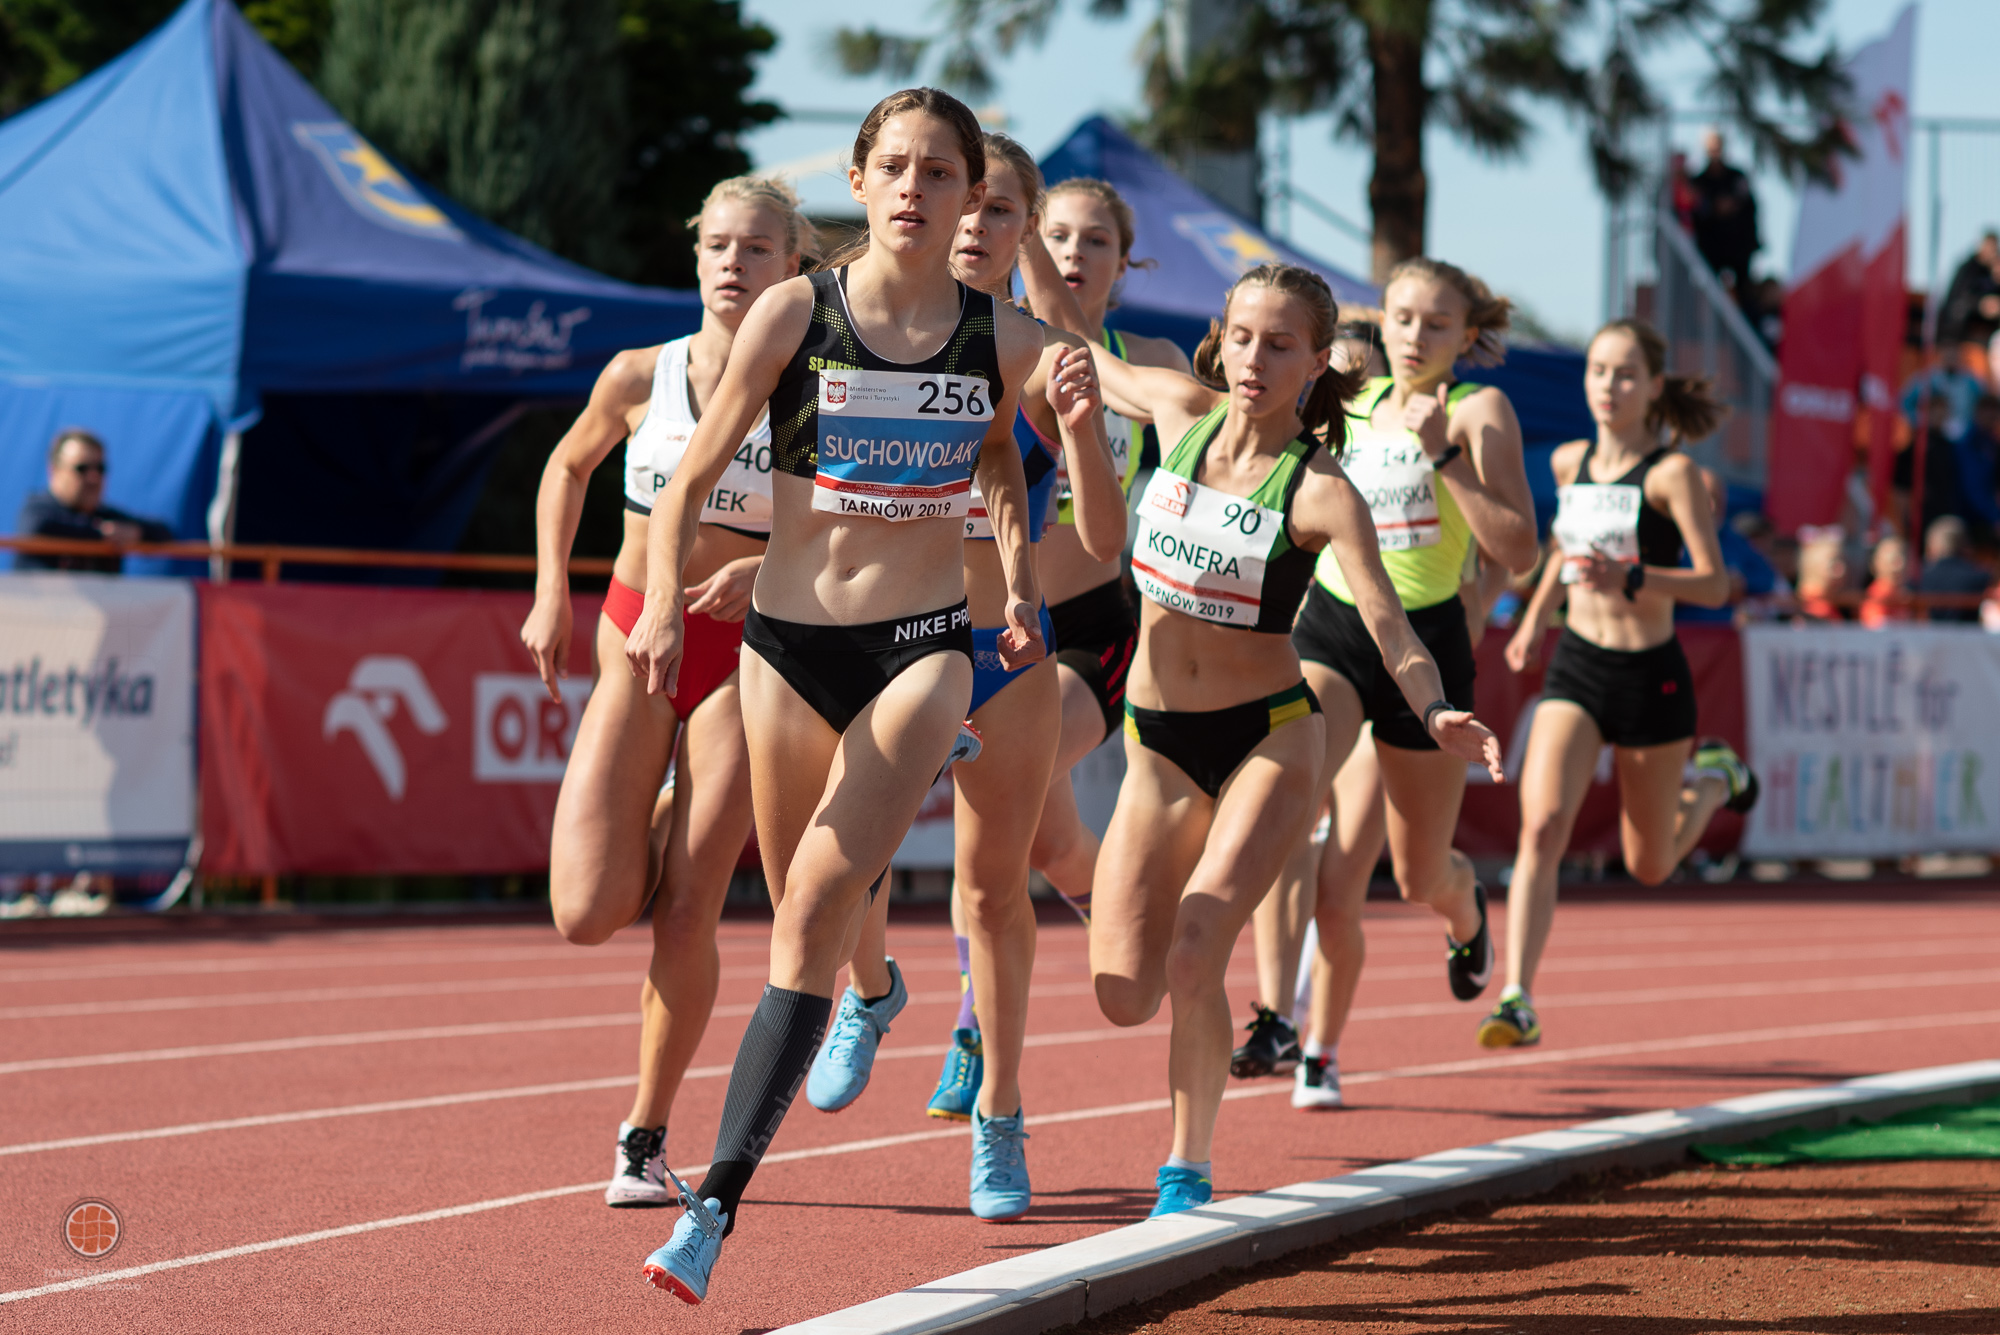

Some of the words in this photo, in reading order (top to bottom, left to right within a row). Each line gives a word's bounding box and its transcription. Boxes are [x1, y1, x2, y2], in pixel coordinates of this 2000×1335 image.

[808, 356, 825, 372] SP
[917, 381, 985, 416] 256
[824, 434, 979, 468] SUCHOWOLAK
[839, 498, 914, 518] TARNÓW
[917, 502, 951, 517] 2019
[1221, 503, 1261, 535] 90
[1148, 528, 1240, 579] KONERA
[1145, 580, 1194, 611] TARNÓW
[1198, 602, 1235, 619] 2019
[894, 615, 947, 642] NIKE
